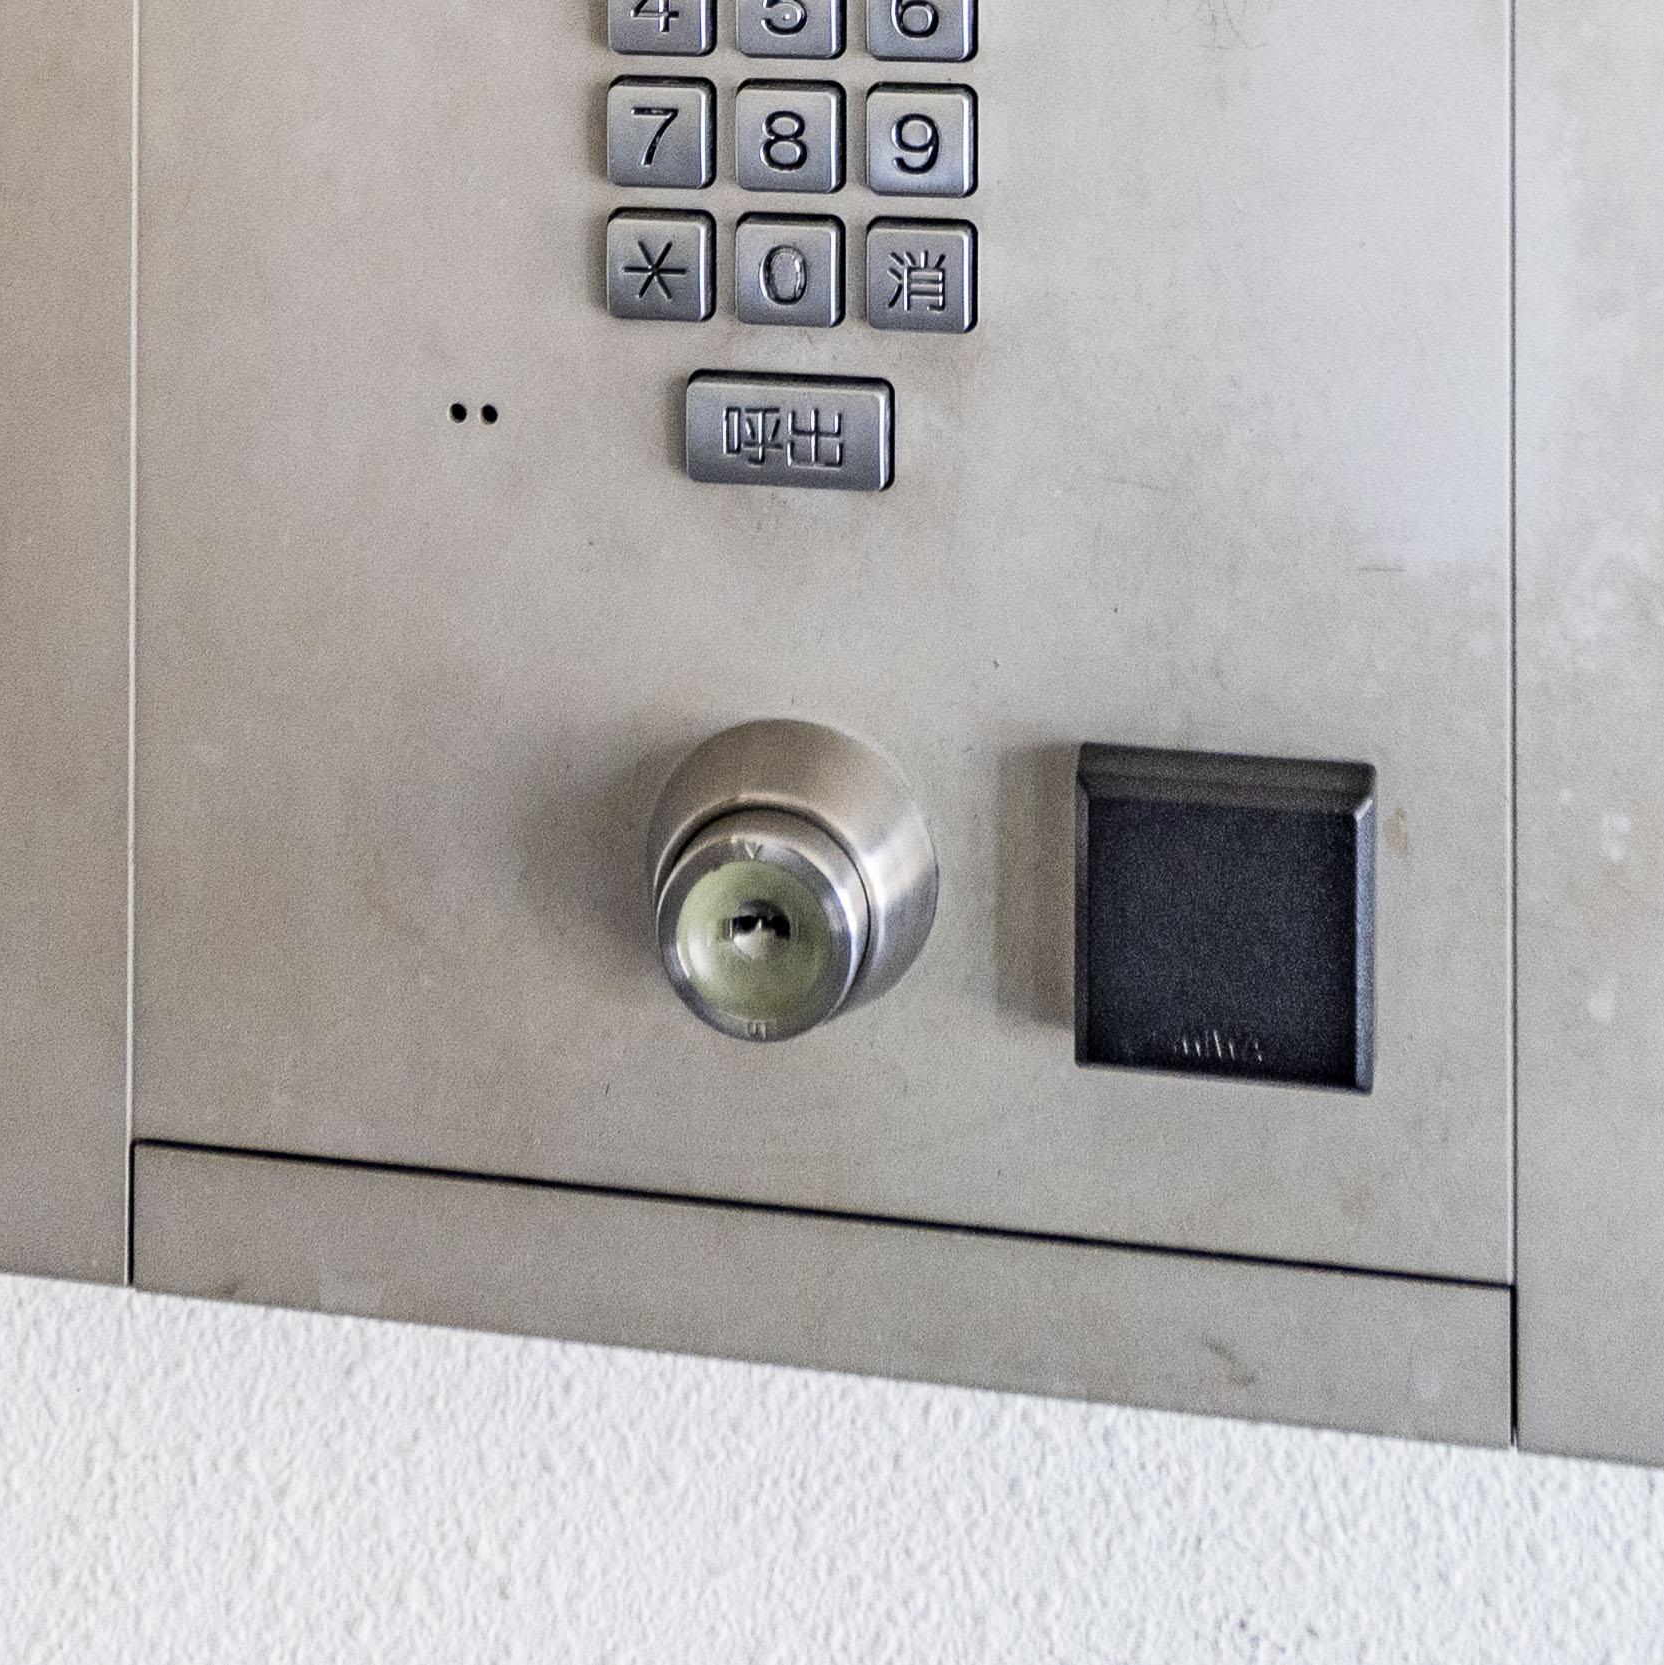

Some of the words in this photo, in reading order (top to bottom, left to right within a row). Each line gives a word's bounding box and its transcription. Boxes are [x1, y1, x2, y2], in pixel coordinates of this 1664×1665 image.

[630, 106, 680, 166] 7
[759, 110, 809, 171] 8
[890, 112, 941, 175] 9
[758, 244, 808, 306] 0
[886, 249, 947, 312] 消
[721, 405, 844, 469] 呼出
